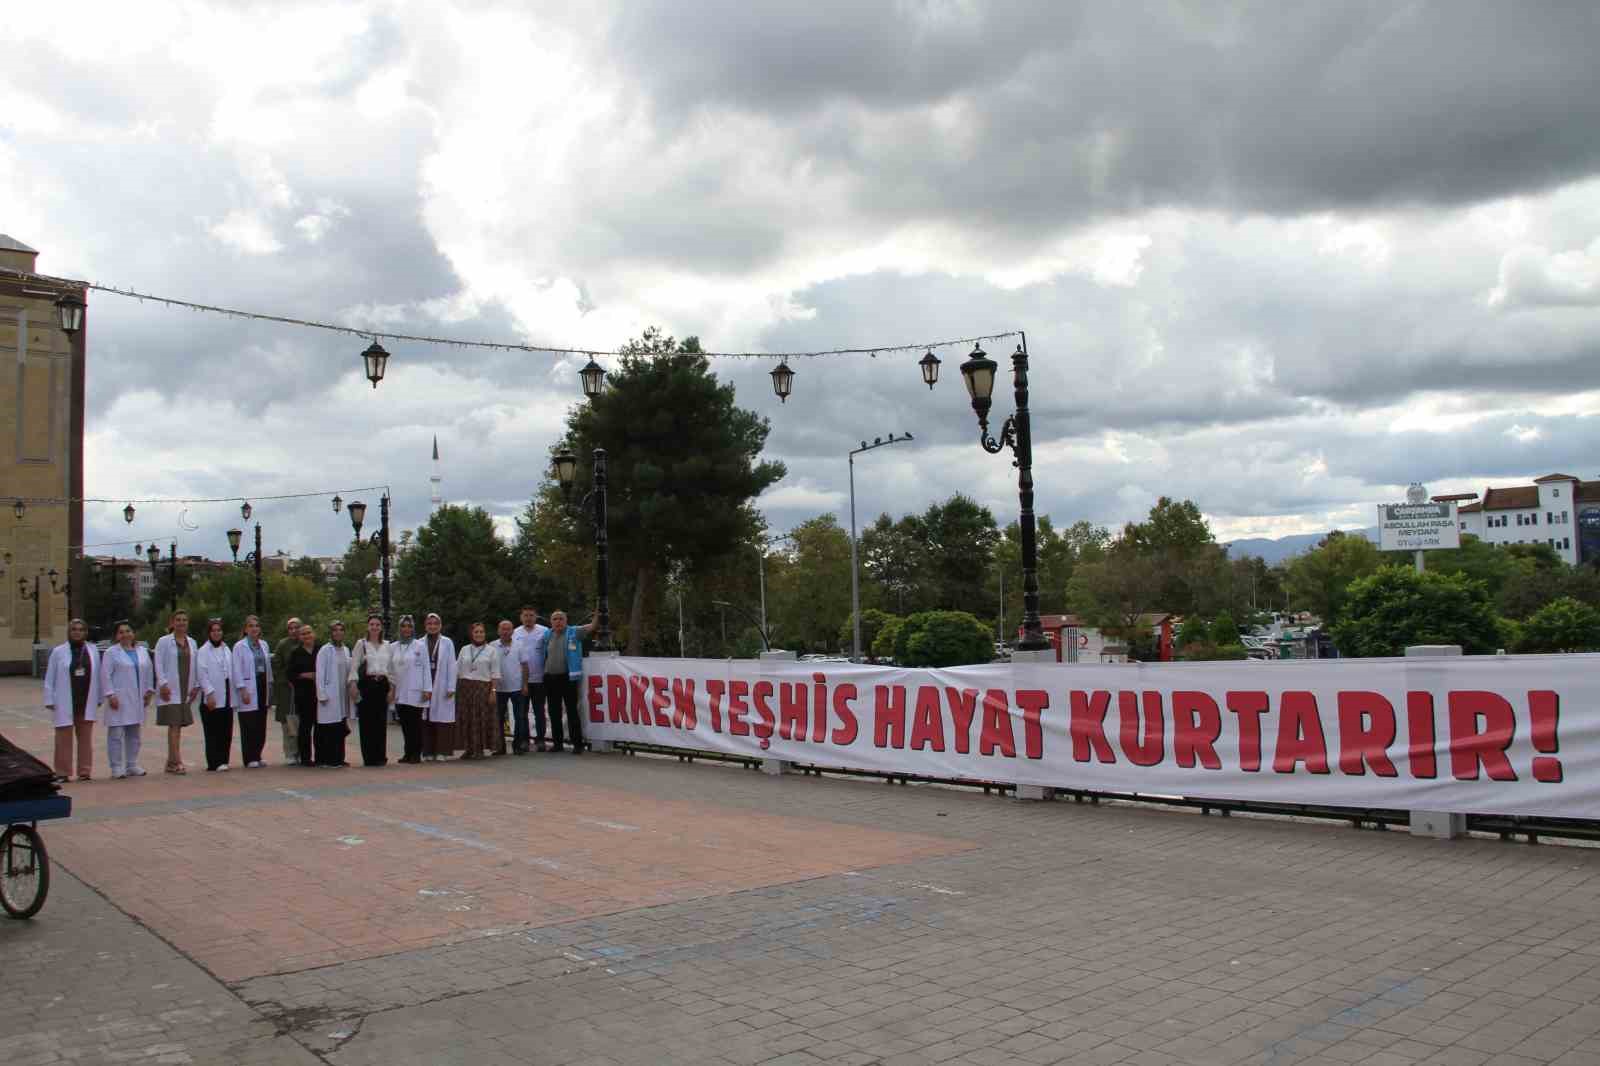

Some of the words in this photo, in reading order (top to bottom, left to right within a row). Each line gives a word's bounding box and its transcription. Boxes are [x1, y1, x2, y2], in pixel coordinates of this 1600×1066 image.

[588, 675, 696, 730] ERKEN
[706, 672, 858, 750] TEŞHİS
[873, 685, 1050, 760] HAYAT
[1070, 690, 1563, 783] KURTARIR!
